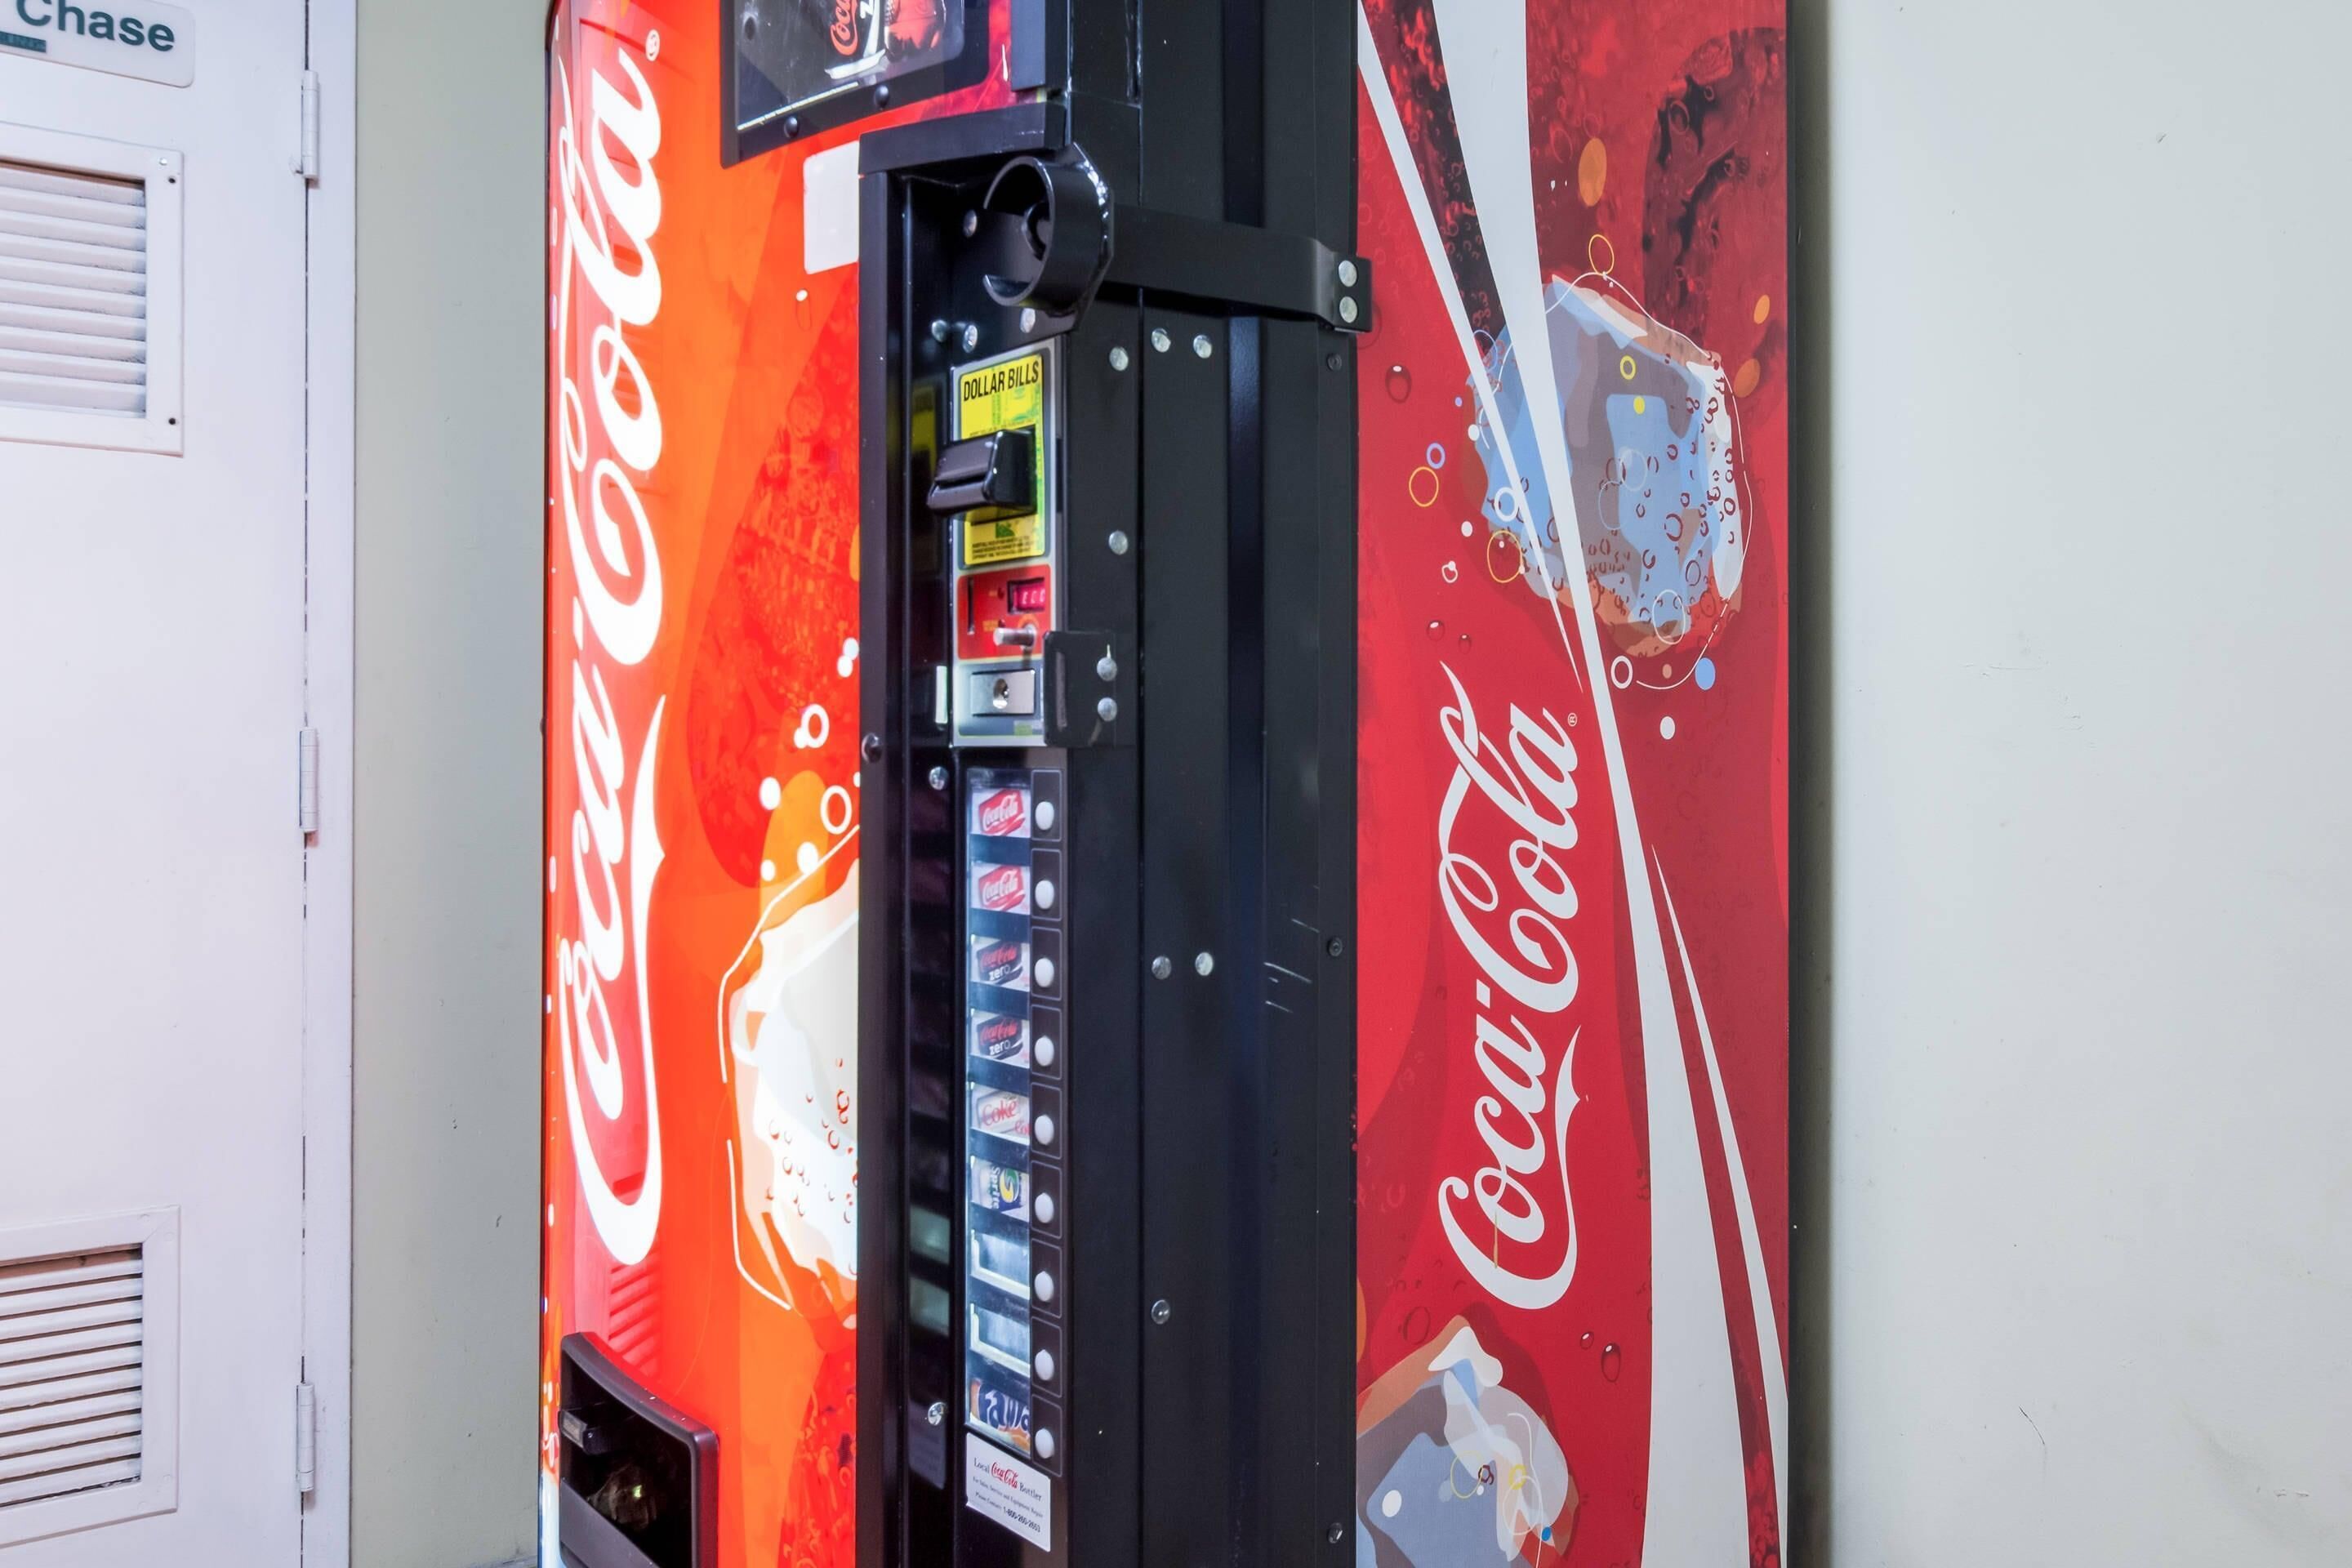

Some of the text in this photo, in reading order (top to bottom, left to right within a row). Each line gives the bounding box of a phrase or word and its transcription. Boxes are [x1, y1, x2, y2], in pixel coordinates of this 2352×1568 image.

[16, 0, 175, 51] Chase
[964, 360, 1039, 402] DOLLAR BILLS
[989, 964, 1011, 981] zero
[989, 1040, 1011, 1056] zero
[982, 1099, 1018, 1126] Coke
[989, 1166, 1000, 1209] Sprite
[974, 1457, 989, 1473] Local
[1019, 1482, 1042, 1502] Bottler
